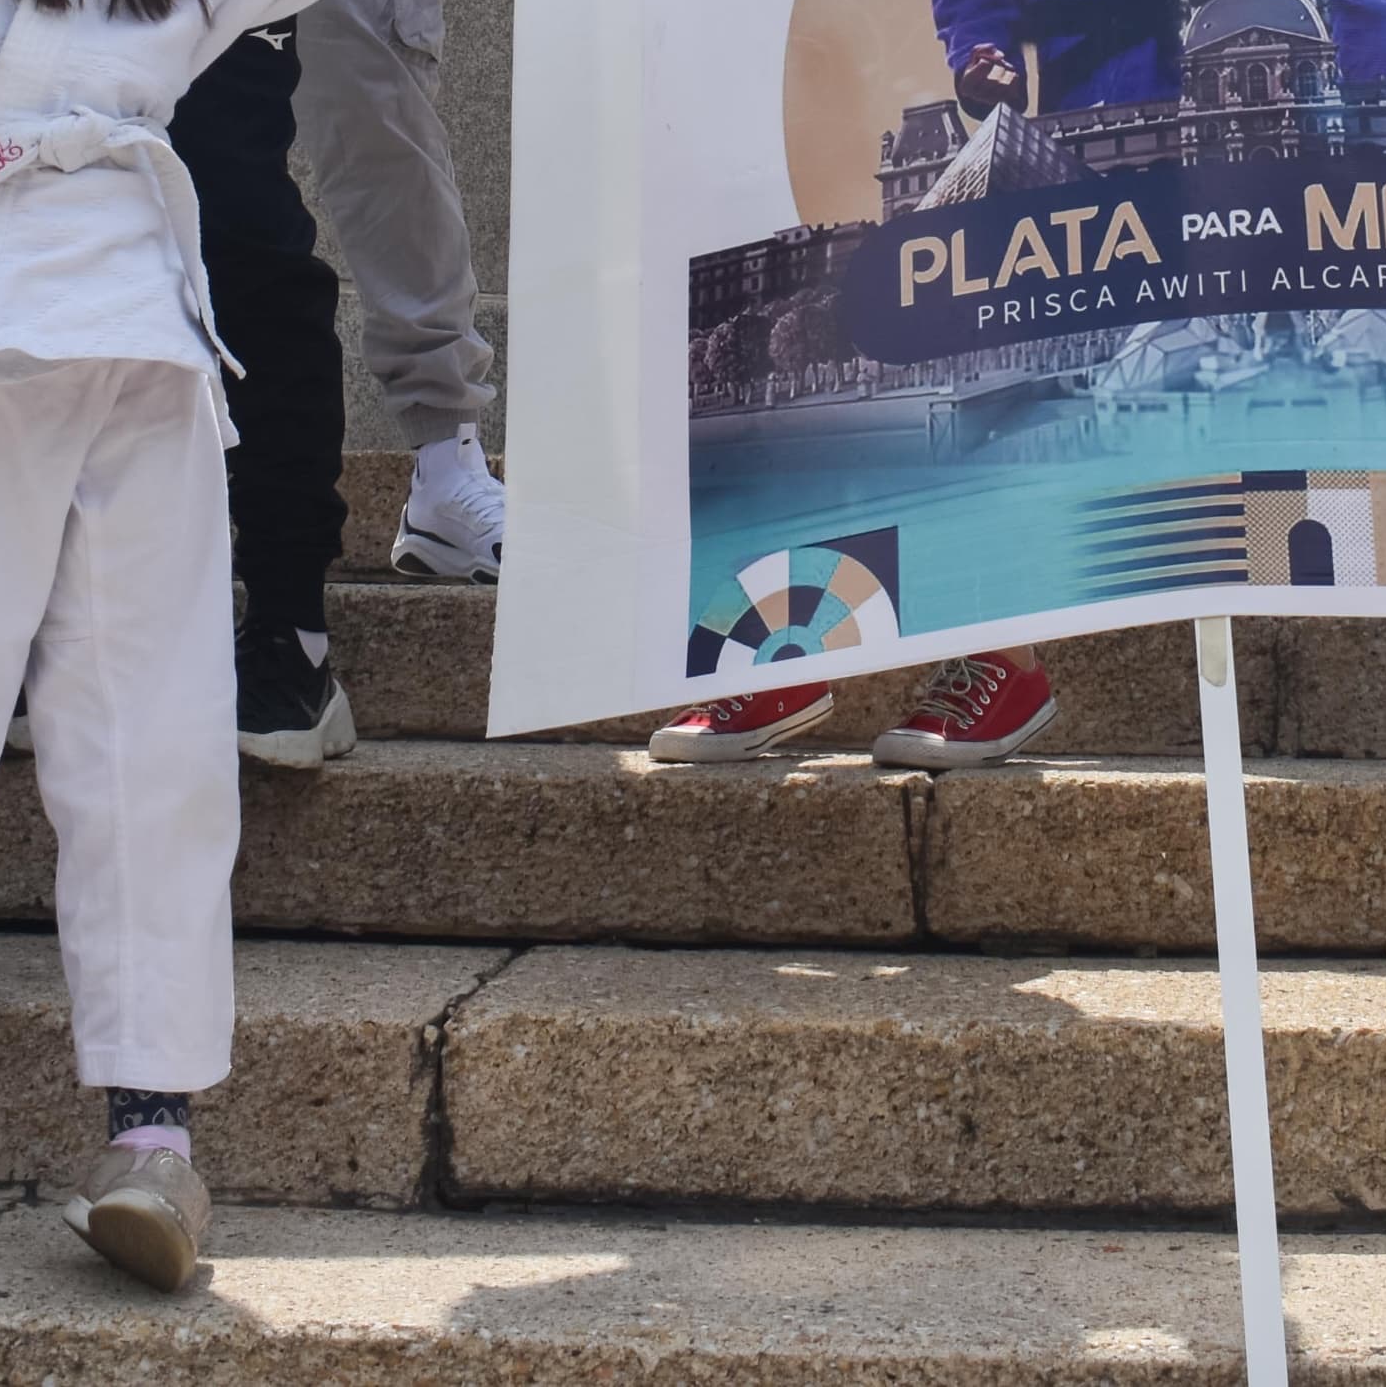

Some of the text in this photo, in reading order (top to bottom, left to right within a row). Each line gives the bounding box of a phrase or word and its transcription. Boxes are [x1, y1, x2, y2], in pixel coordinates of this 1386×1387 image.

[900, 201, 1162, 308] PLATA
[1182, 207, 1283, 241] PARA
[977, 284, 1116, 329] PRISCA
[1136, 269, 1246, 303] AWITI
